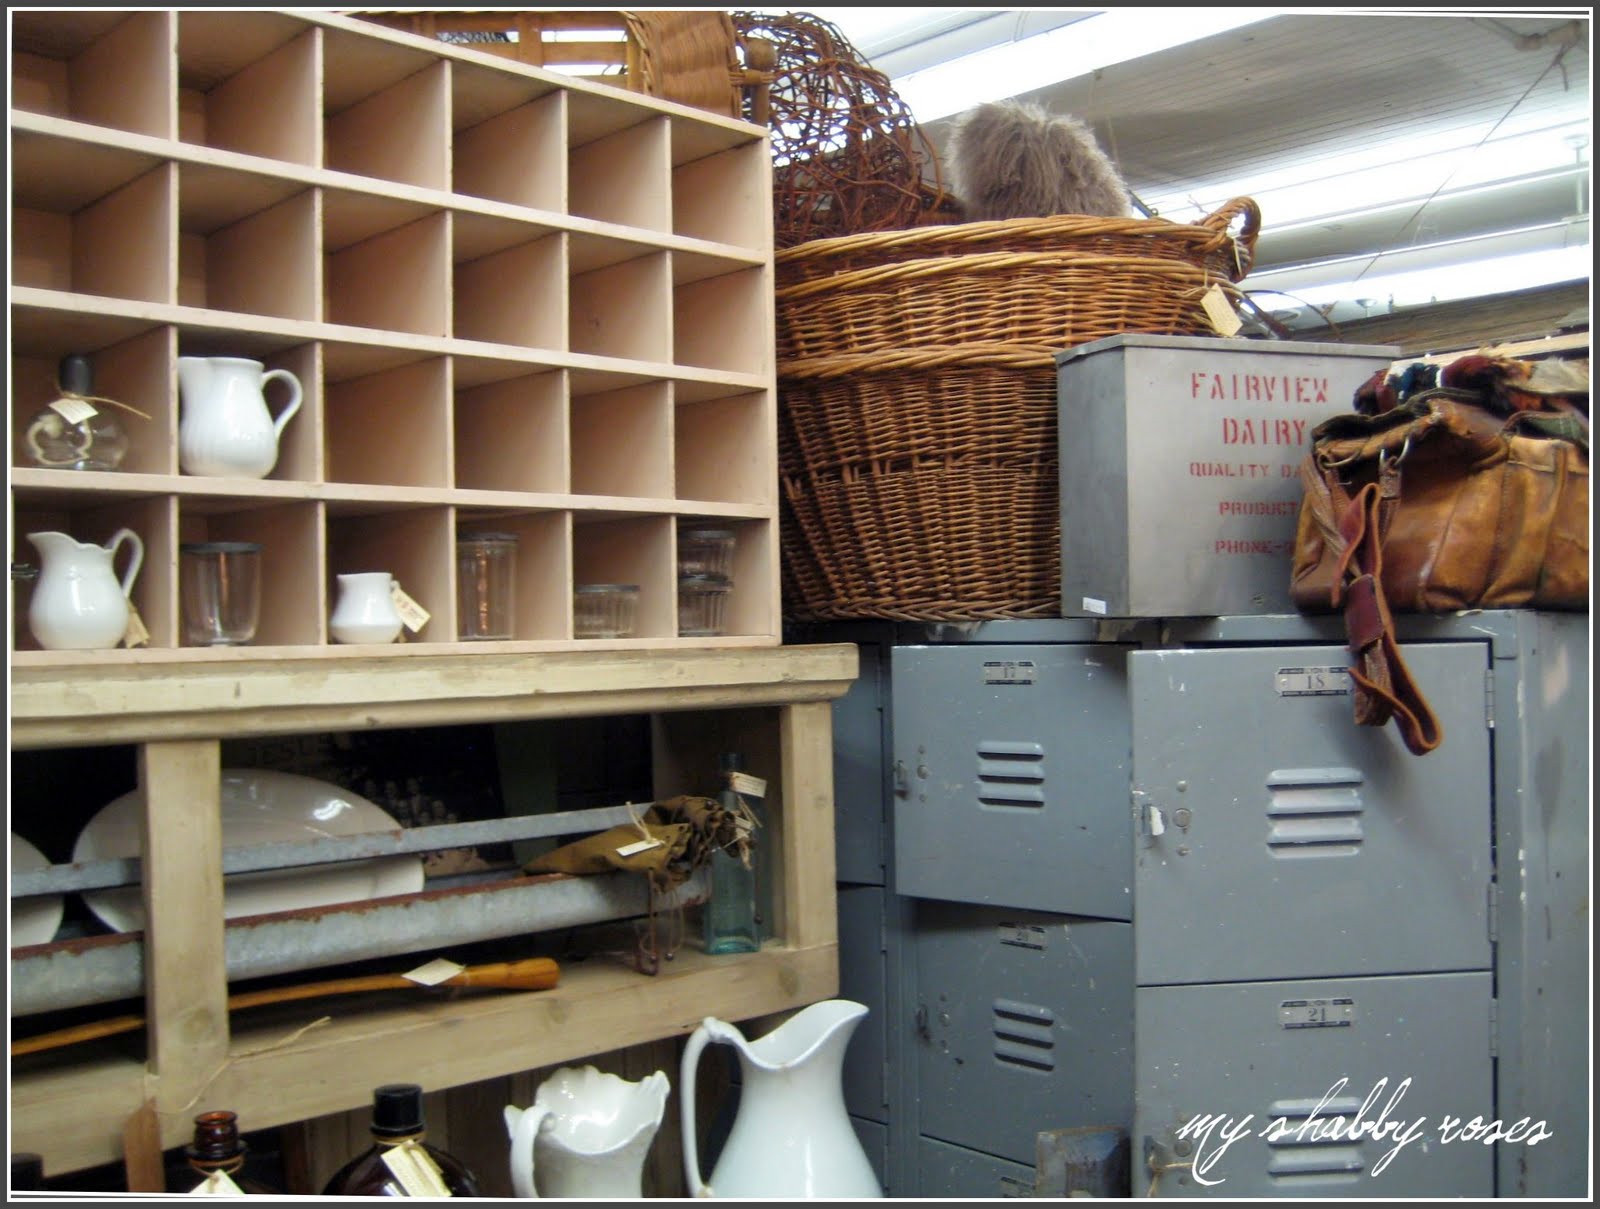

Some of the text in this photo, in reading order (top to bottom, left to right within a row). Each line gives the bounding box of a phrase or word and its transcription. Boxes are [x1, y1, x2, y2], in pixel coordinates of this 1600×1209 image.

[1191, 372, 1328, 403] FAIRVIEW
[1222, 418, 1306, 446] DAIRY
[1190, 462, 1303, 479] QUALITY DA
[1306, 674, 1325, 689] 18
[1308, 1007, 1326, 1021] 21
